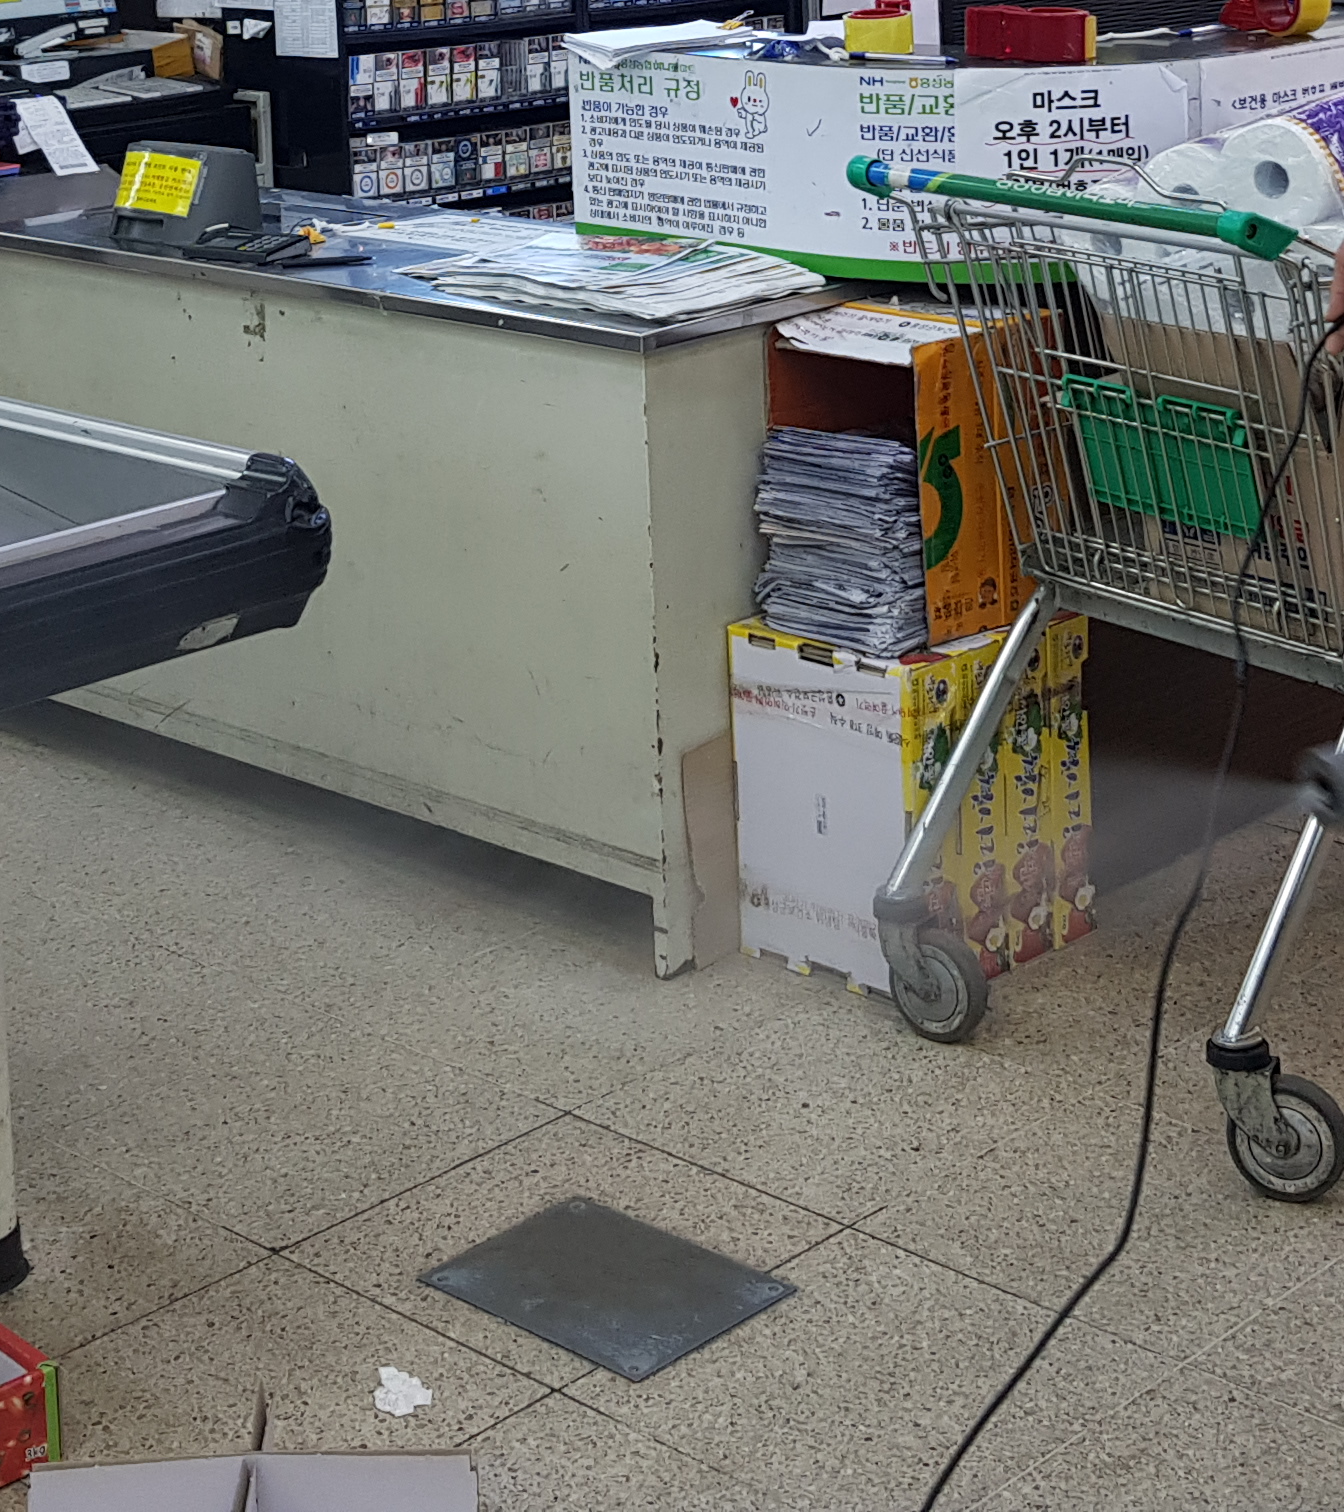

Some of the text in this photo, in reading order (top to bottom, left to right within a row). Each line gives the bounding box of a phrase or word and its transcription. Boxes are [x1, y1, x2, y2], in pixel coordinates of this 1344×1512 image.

[579, 71, 701, 101] 반품처리 규정
[859, 76, 884, 86] NH
[1033, 89, 1101, 112] 마스크
[1272, 89, 1296, 105] 마스크
[648, 106, 669, 117] 경우
[993, 114, 1130, 140] 오후 2시부터
[1004, 148, 1038, 170] 1인
